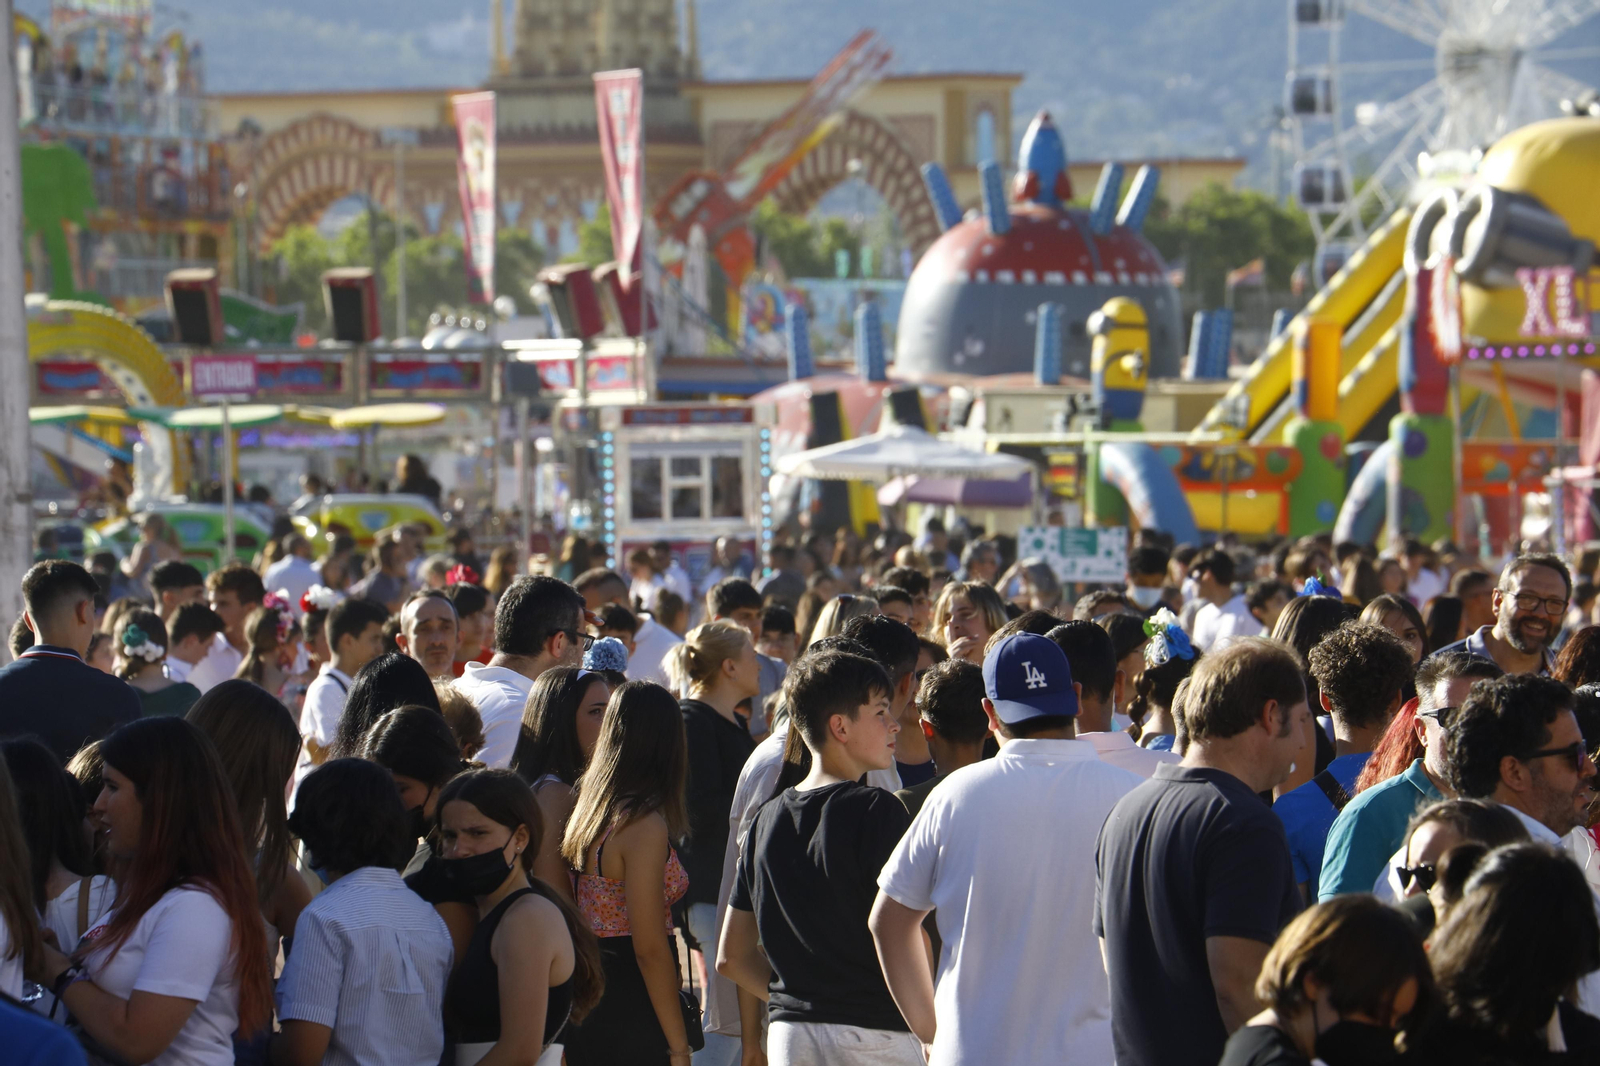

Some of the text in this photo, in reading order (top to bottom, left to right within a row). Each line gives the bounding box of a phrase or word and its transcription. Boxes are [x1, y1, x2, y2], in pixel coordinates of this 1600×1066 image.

[1515, 266, 1590, 337] XL
[194, 361, 254, 390] ENTRADA
[1021, 661, 1048, 690] LA
